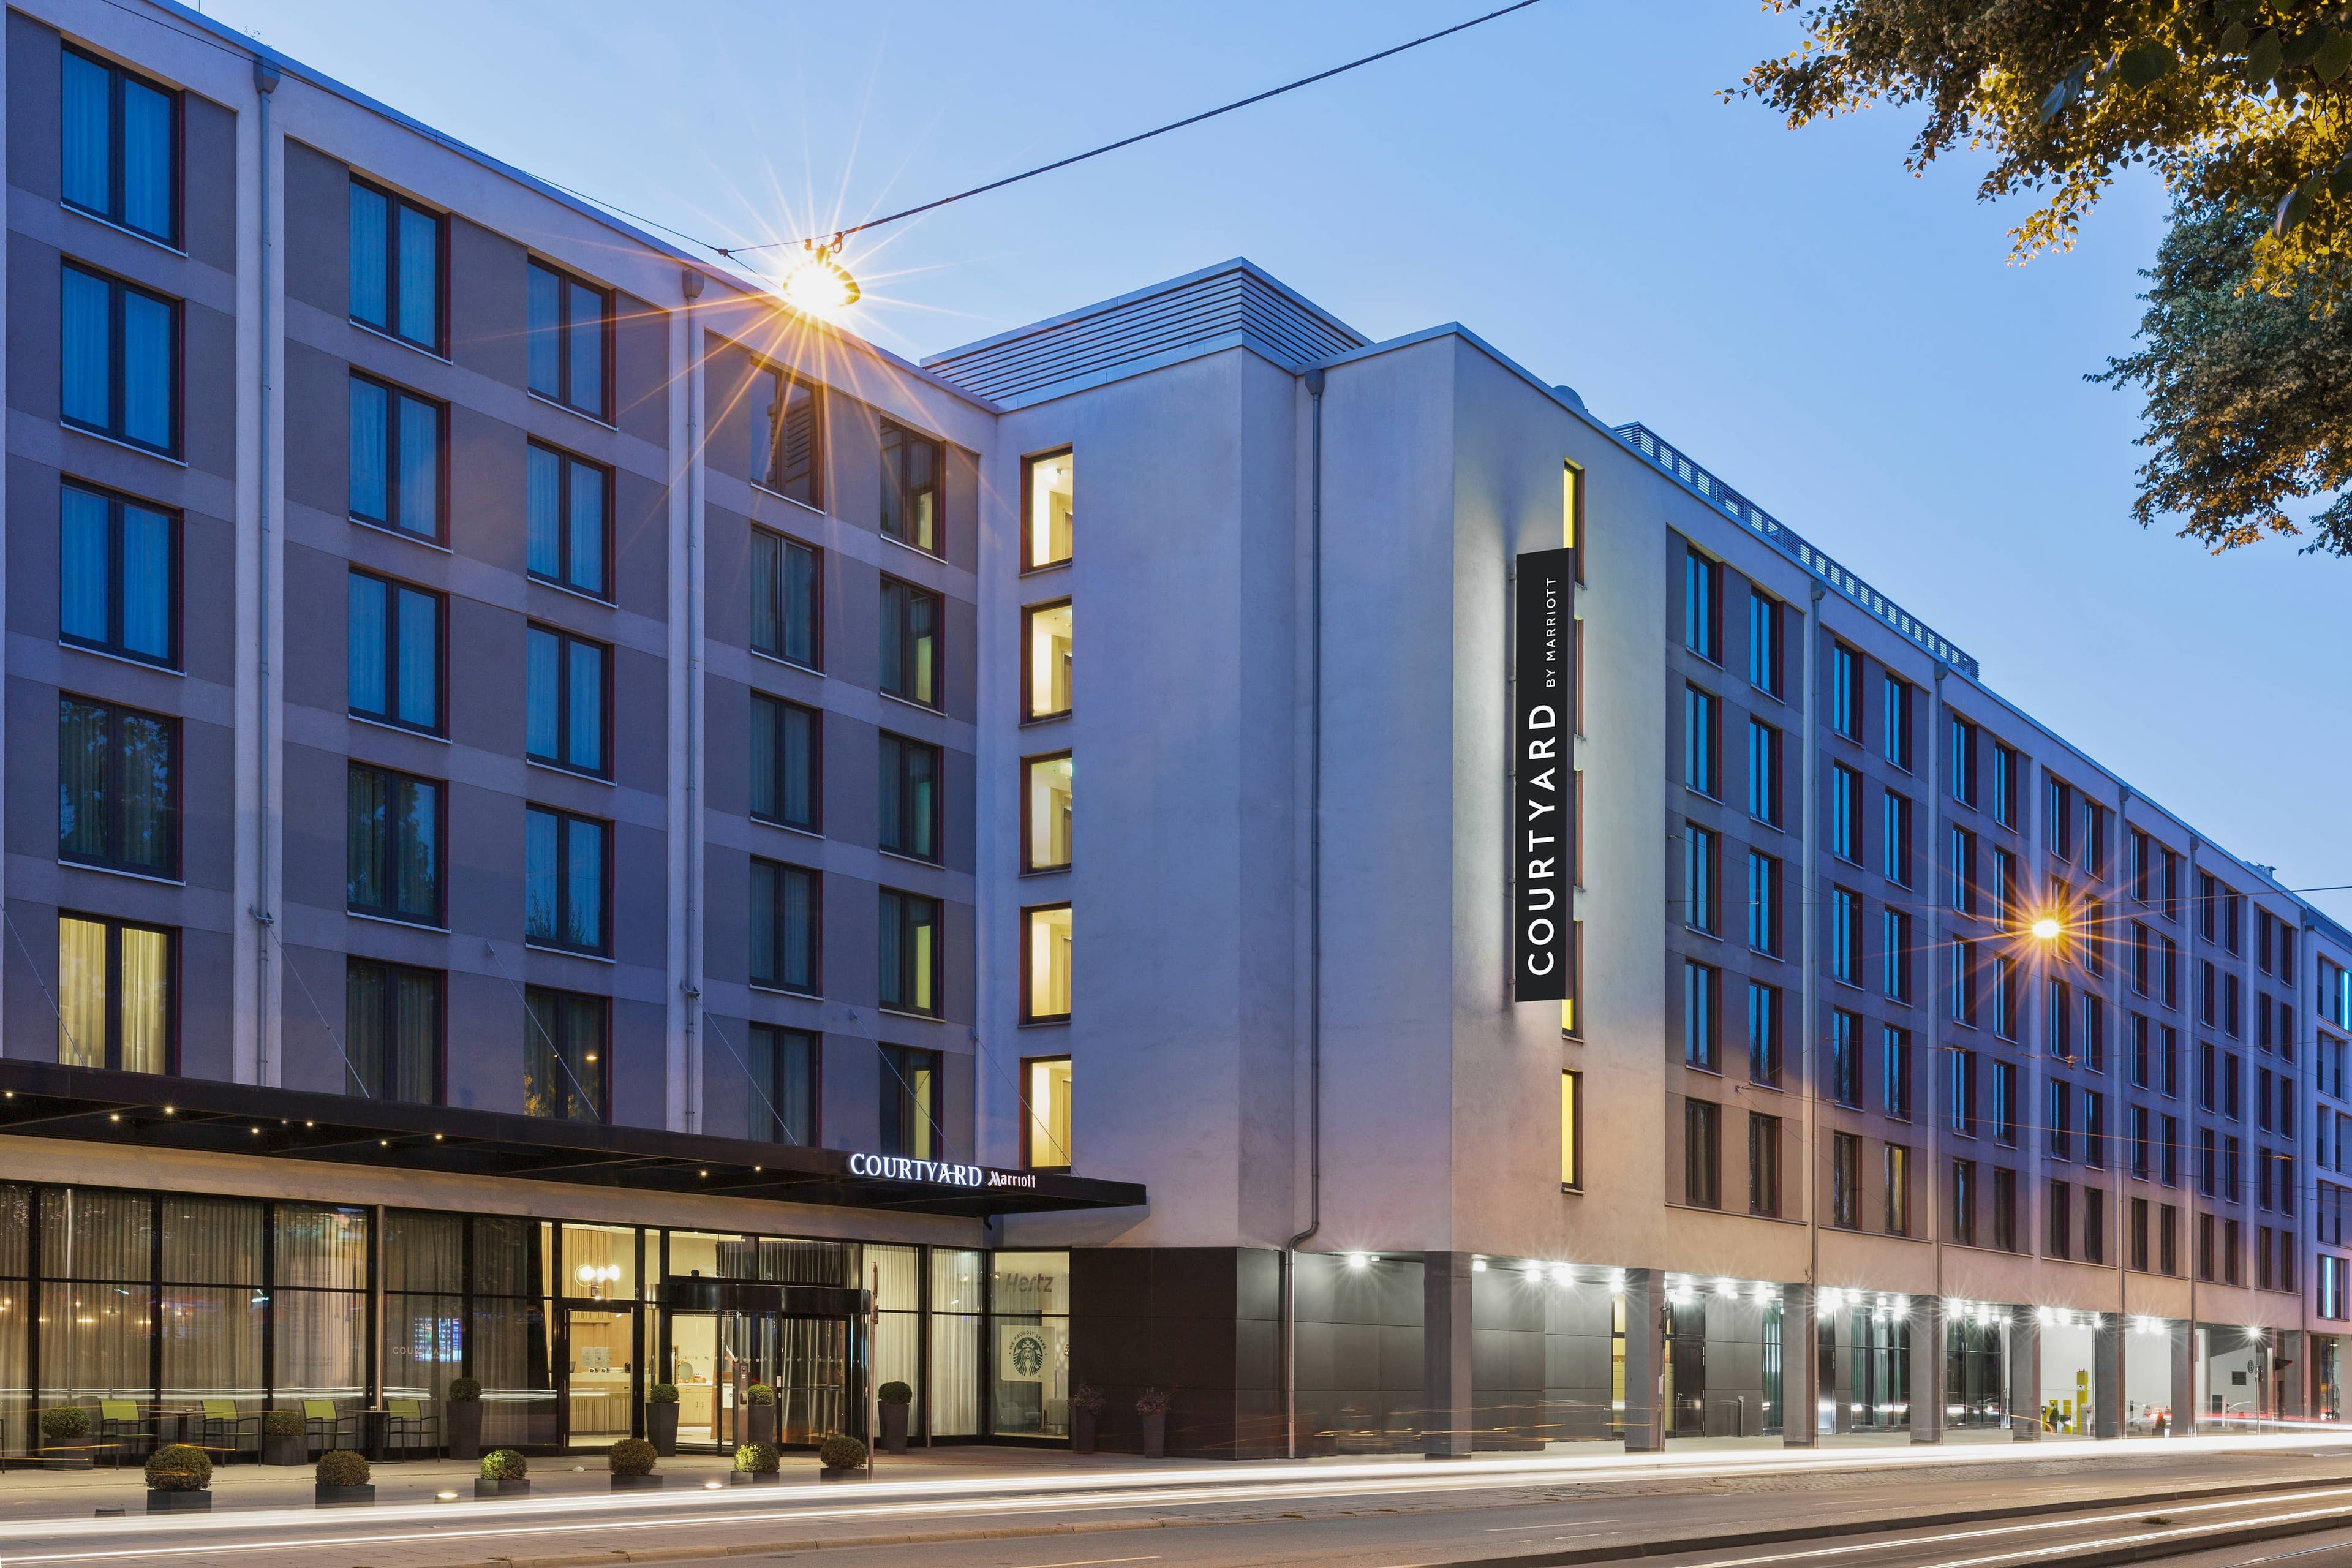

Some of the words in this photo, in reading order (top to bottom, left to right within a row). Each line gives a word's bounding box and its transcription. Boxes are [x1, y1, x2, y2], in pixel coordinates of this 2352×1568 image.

[1546, 578, 1556, 662] MARRIOTT
[1546, 669, 1556, 688] BY
[1528, 704, 1556, 976] COURTYARD
[850, 1153, 982, 1187] COURTYARD
[987, 1170, 1036, 1188] Marriott
[1005, 1273, 1054, 1292] Hertz
[1009, 1341, 1015, 1350] WE
[1014, 1330, 1035, 1340] PROUDLY
[1036, 1334, 1047, 1350] SERVE
